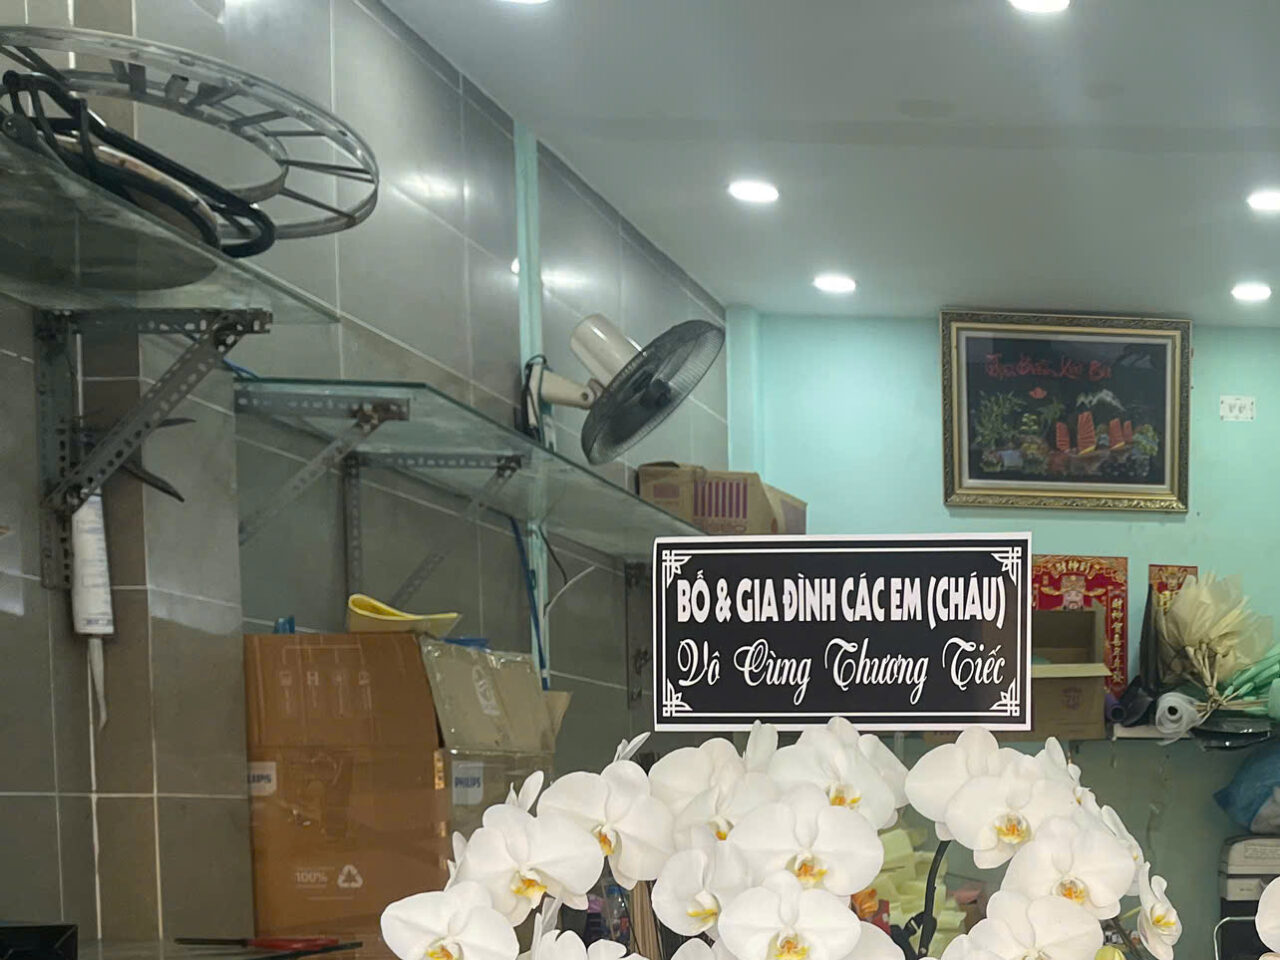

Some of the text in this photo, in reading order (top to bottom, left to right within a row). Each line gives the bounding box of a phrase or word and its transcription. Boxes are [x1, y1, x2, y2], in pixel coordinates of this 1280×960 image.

[677, 570, 1006, 629] BỐ & GIA ĐÌNH CÁC EM (CHÁU)
[677, 637, 1006, 705] Vô Cùng Thương Tiếc
[454, 776, 481, 789] PHILIPS
[295, 872, 328, 883] 100%
